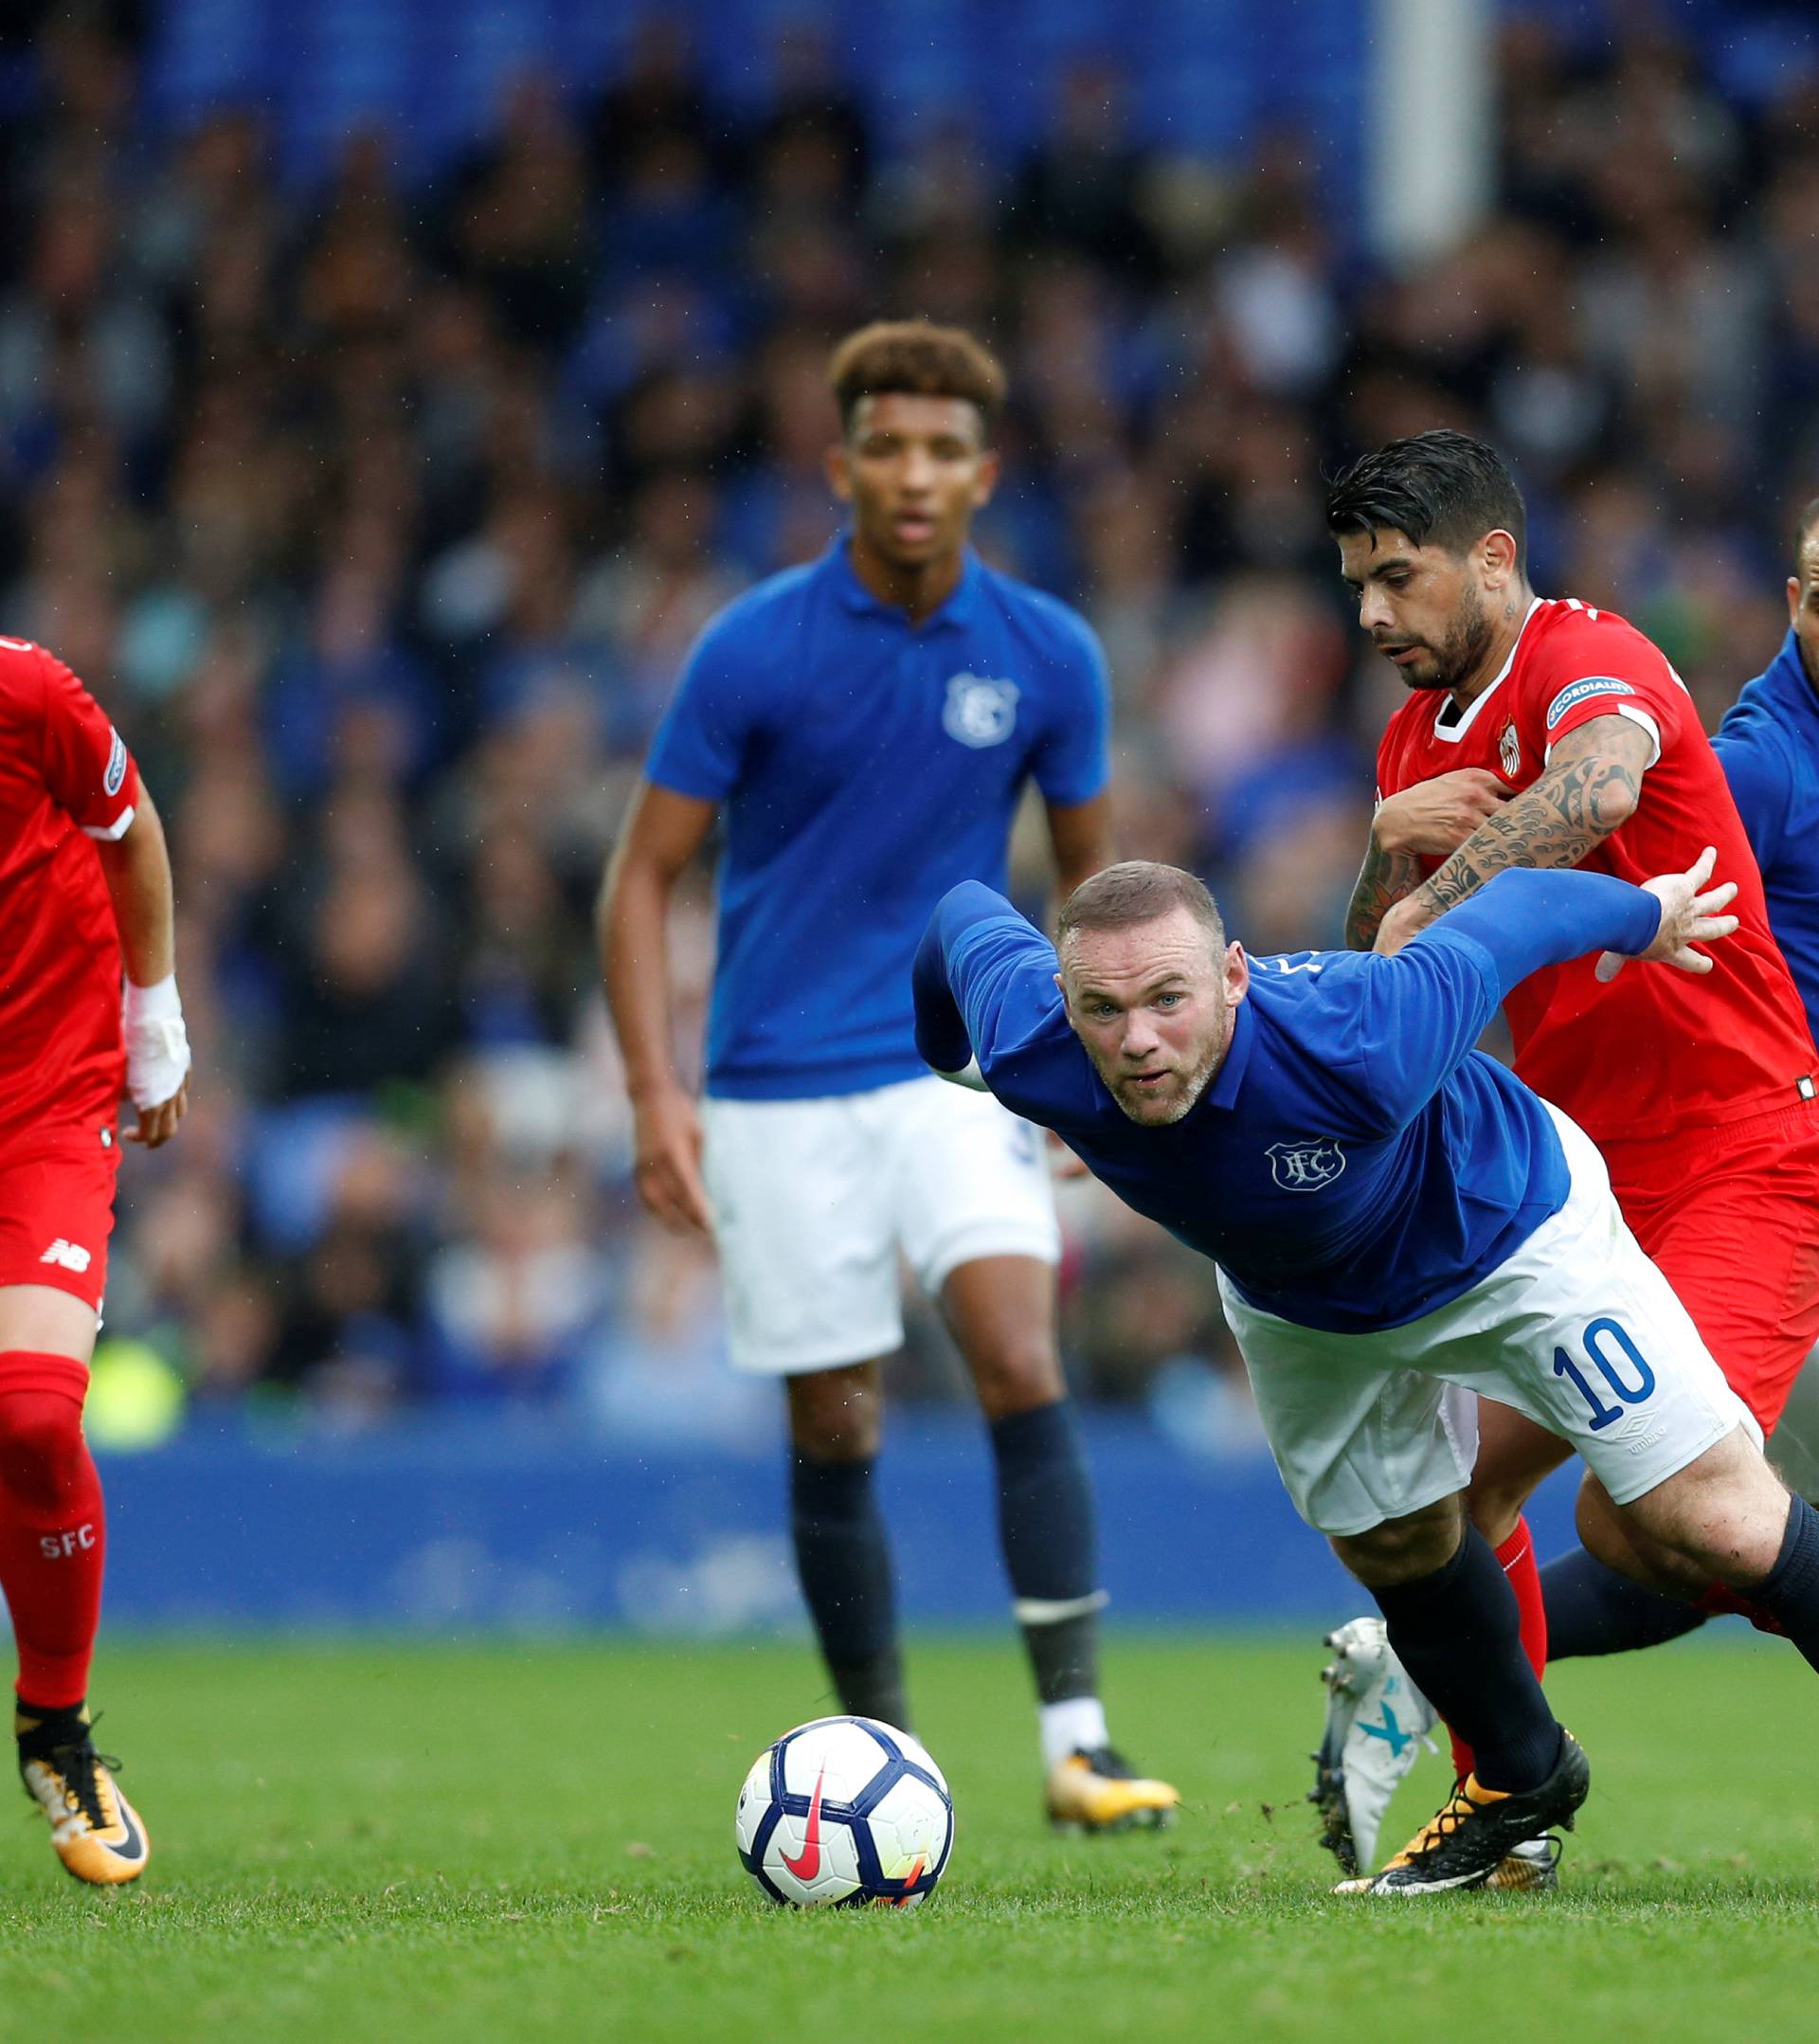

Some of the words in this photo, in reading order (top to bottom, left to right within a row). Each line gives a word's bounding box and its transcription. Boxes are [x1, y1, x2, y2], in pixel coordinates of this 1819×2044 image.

[1555, 681, 1630, 713] CORDIALITY
[1554, 1317, 1655, 1431] 10
[40, 1523, 96, 1560] SFC
